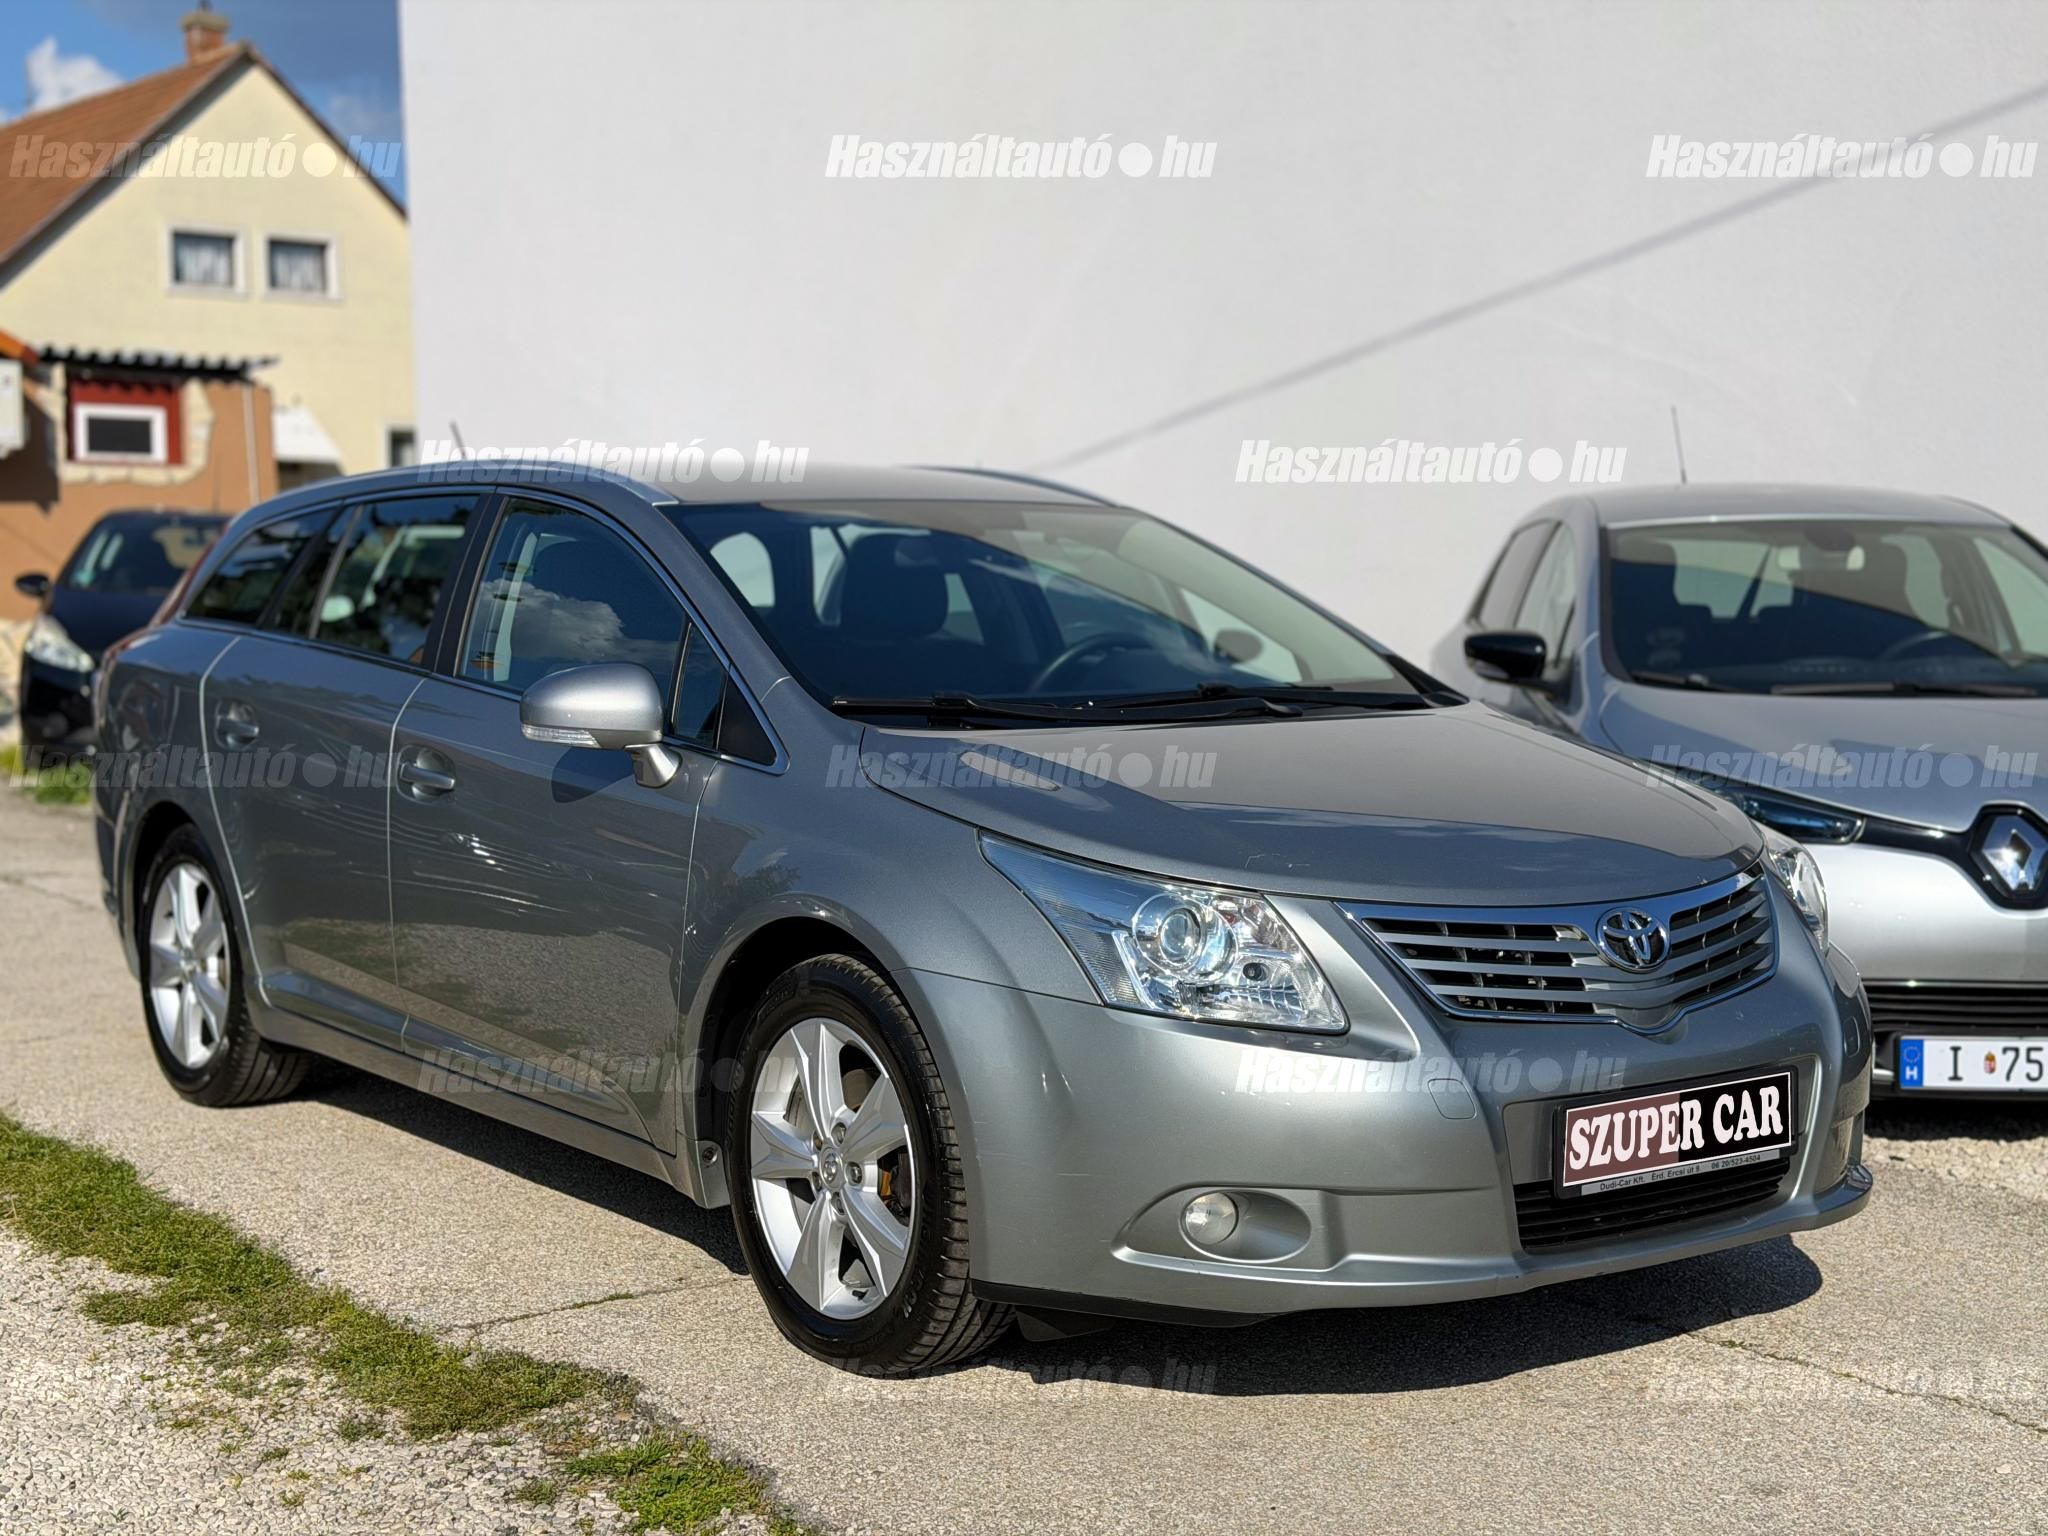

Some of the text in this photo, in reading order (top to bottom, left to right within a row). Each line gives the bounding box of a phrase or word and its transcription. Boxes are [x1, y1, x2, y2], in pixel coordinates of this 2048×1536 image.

[1905, 1066, 1918, 1080] H
[1569, 1085, 1784, 1170] SZUPER CAR
[1600, 1178, 1632, 1191] Dudi-Car
